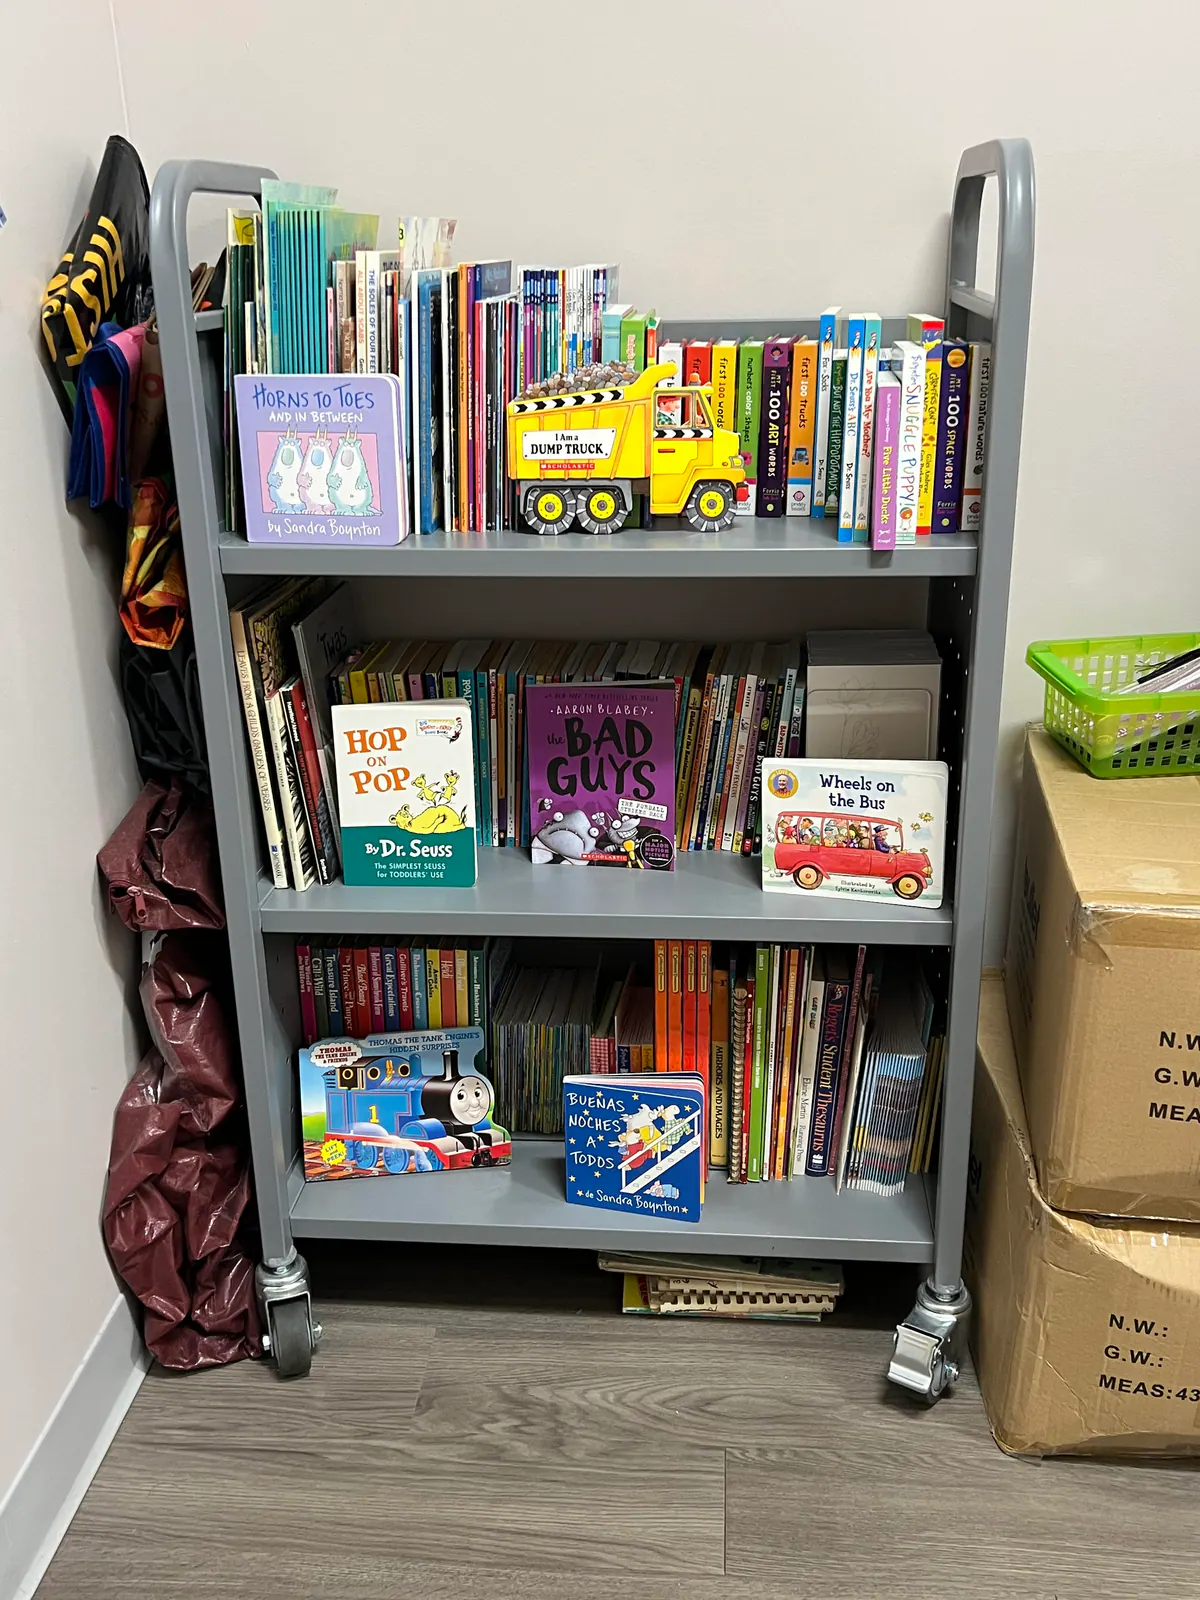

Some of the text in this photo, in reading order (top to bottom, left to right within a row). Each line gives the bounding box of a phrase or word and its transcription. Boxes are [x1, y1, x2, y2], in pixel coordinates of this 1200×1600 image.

[368, 317, 375, 327] OF
[821, 357, 830, 392] Fox Socks
[981, 357, 990, 381] first
[252, 382, 375, 410] HORNS TO TOES
[716, 357, 729, 429] first 100 words
[742, 357, 754, 443] numbers colors shapes
[768, 389, 781, 420] 100
[798, 357, 811, 429] first 100 trucks
[846, 372, 858, 437] Dr. Seuss's ABC
[269, 411, 363, 423] AND IN BETWEEN
[862, 369, 873, 458] Are You My Mother?
[977, 400, 987, 432] nature
[555, 433, 558, 441] I
[560, 433, 573, 441] Am
[767, 422, 780, 446] ART
[828, 385, 844, 491] BUT NOT THE HIPPOPOTAMUS
[899, 384, 922, 507] SNUGGLE PUPPY!
[943, 395, 960, 489] 100 SPACE WORDS
[975, 432, 984, 461] words
[530, 443, 604, 455] DUMP TRUCK
[767, 447, 776, 477] WORDS
[845, 473, 853, 490] Seuss
[881, 446, 893, 525] Five Little Ducks
[267, 518, 381, 540] by Sandra Boynton
[237, 650, 249, 679] LEAVES
[242, 679, 252, 702] FROM
[556, 703, 648, 715] AARON BLABEY
[343, 726, 408, 755] HOP
[547, 716, 653, 758] the BAD
[779, 725, 787, 737] BAD
[253, 739, 264, 771] GARDEN
[757, 741, 767, 755] the
[366, 756, 387, 767] ON
[755, 755, 764, 775] BAD
[258, 771, 267, 780] OF
[349, 767, 411, 795] POP
[546, 753, 656, 800] GUYS
[819, 773, 895, 793] Wheels on
[260, 782, 272, 812] VERSES
[749, 776, 762, 802] GUYS
[828, 792, 886, 810] the Bus
[364, 839, 453, 858] By Dr. Seuss
[374, 862, 446, 870] The SIMPLEST SEUSS
[430, 871, 444, 879] USE
[840, 879, 876, 890] Illustrated by
[312, 957, 324, 996] Call Wild
[399, 953, 407, 986] Gulliver's
[440, 960, 454, 979] Heidi
[326, 954, 339, 1013] Treasure Island
[356, 964, 368, 1007] Black Beauty
[385, 953, 397, 1017] Great Expectations
[413, 953, 422, 1019] Robinson Crusoe
[342, 964, 353, 1031] Prince Pauper
[473, 984, 481, 1018] Huckleberry
[368, 1032, 480, 1047] THOMAS THE TANK ENGINE'S
[389, 1042, 460, 1053] HIDDEN SURPRISES
[812, 1003, 842, 1152] Roget's Student Thesaurus
[566, 1092, 626, 1112] BUENAS
[715, 1045, 723, 1139] MIRRORS AND IMAGES
[800, 1078, 811, 1120] Elaine Martin
[368, 1105, 380, 1124] 1
[568, 1114, 621, 1133] NOCHES
[325, 1143, 338, 1152] LIFT
[586, 1135, 597, 1148] A
[797, 1124, 806, 1148] Running
[570, 1151, 615, 1169] TODOS
[585, 1189, 680, 1213] de Sandra Boynton
[1108, 1313, 1168, 1338] N.W.:
[1104, 1345, 1164, 1368] G.W.:
[1099, 1374, 1200, 1402] MEAS:43
